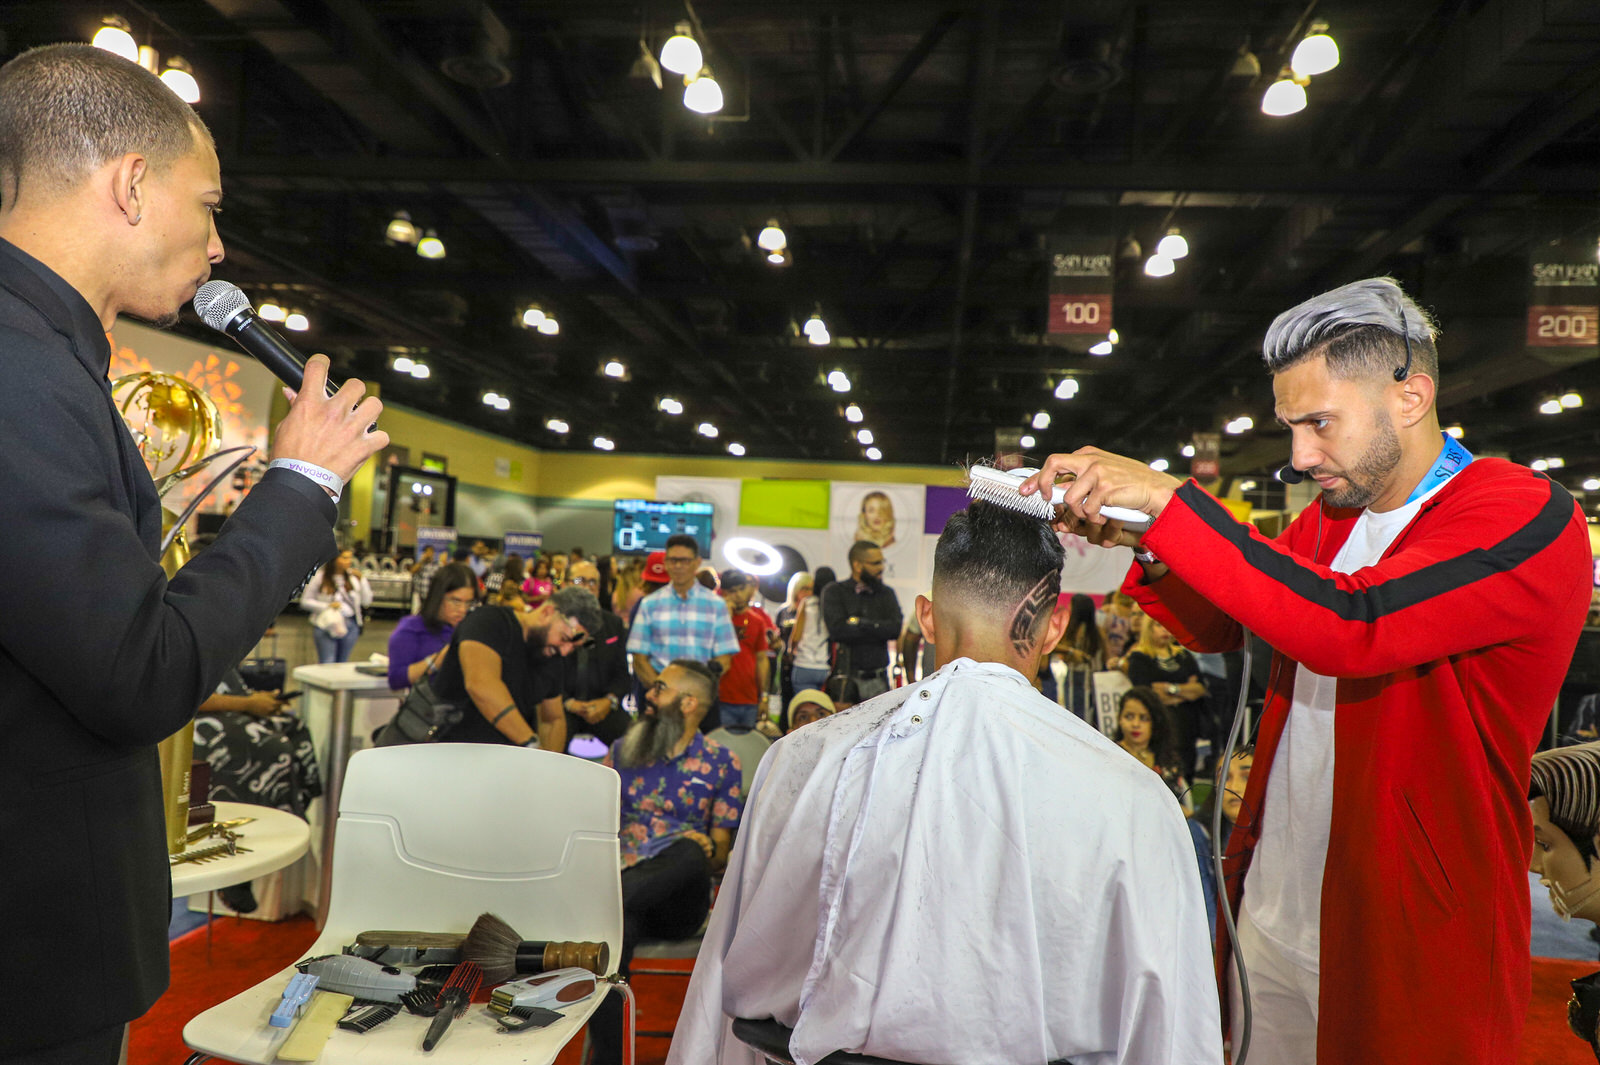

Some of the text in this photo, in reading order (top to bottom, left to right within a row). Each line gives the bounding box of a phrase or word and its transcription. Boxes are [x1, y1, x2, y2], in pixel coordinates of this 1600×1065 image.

[1062, 302, 1100, 324] 100
[1538, 314, 1587, 338] 200
[289, 463, 334, 482] JORDANA
